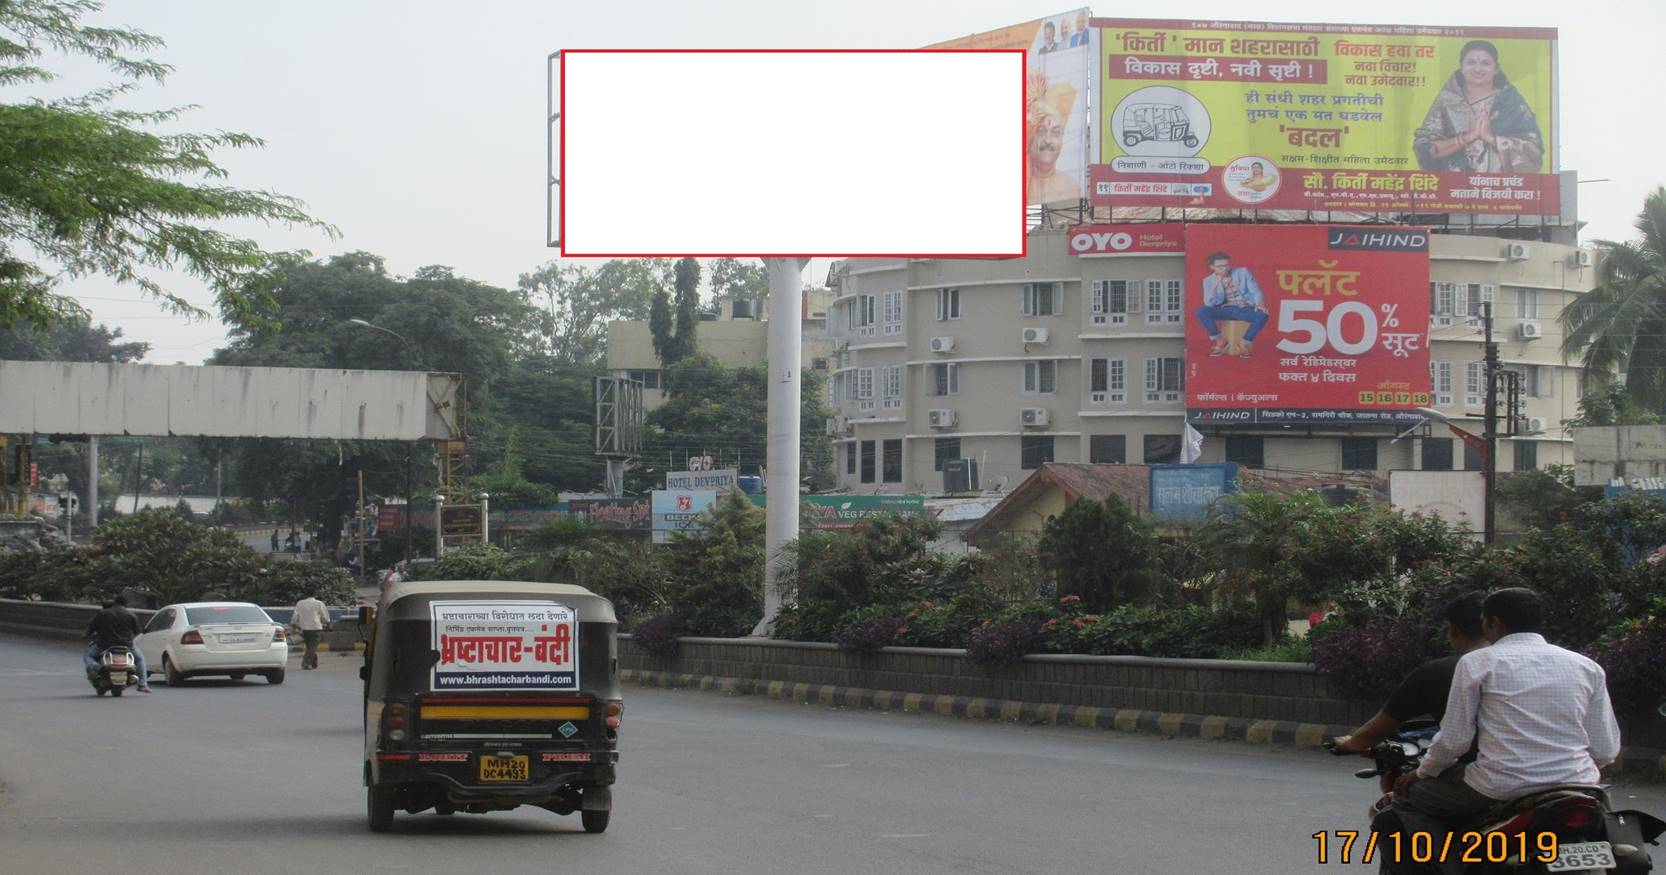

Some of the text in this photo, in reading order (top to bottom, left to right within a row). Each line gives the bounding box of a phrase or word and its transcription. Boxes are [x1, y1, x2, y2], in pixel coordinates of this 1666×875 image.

[1184, 38, 1224, 55] मान
[1231, 36, 1319, 57] शहरासाठी
[1334, 40, 1435, 58] विकास हवा तर
[1125, 57, 1181, 75] विकास
[1188, 59, 1223, 79] दृष्टी,
[1230, 60, 1262, 77] नवी
[1268, 61, 1302, 81] सृष्टी
[1354, 59, 1416, 73] नवा विचार!
[1344, 74, 1368, 86] नवा
[1246, 90, 1259, 105] ही
[1265, 89, 1293, 105] संधी
[1299, 93, 1326, 106] शहर
[1285, 109, 1307, 123] एक
[1313, 110, 1333, 121] मत
[1117, 160, 1147, 170] निशाणी
[1344, 155, 1371, 165] महिला
[1333, 172, 1368, 190] किर्ती
[1409, 173, 1438, 191] शिंदे
[1450, 188, 1480, 200] मताने
[1483, 188, 1512, 200] विजयी
[1515, 190, 1535, 201] करा
[1072, 232, 1133, 251] OYO
[1276, 300, 1378, 355] 50
[1381, 332, 1424, 358] सूट
[1280, 356, 1298, 367] सर्व
[1279, 372, 1307, 382] फक्त
[1323, 369, 1356, 382] दिवस
[1360, 393, 1427, 404] 15 16 17 18
[668, 475, 735, 488] HOTEL DEVPRIYA
[548, 610, 568, 620] देणारे
[440, 675, 572, 685] www.bhrashtacharbandi.com
[488, 760, 526, 769] MH20
